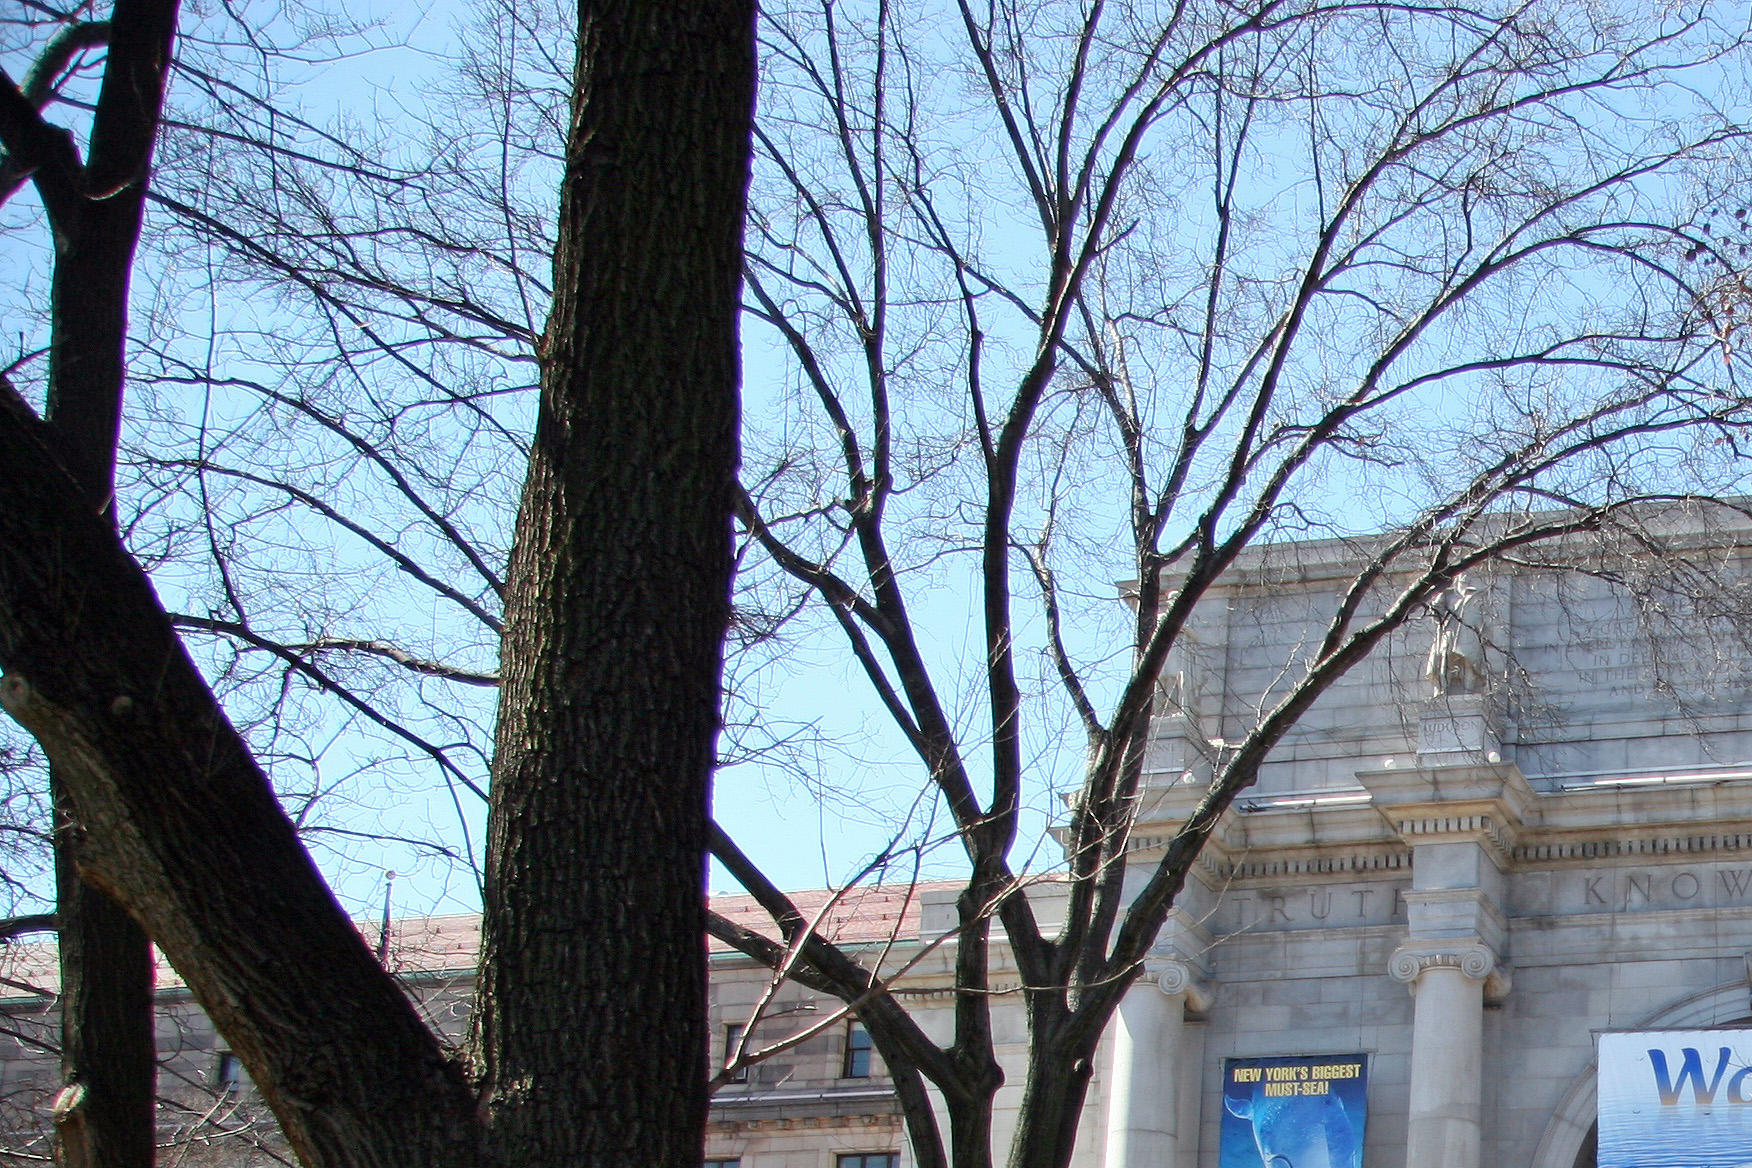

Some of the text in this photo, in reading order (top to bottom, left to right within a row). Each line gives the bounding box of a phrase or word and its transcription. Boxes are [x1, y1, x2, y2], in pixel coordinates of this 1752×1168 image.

[1234, 1064, 1361, 1083] NEW YORK'S BIGGEST
[1265, 1081, 1329, 1097] MUST-SEA!
